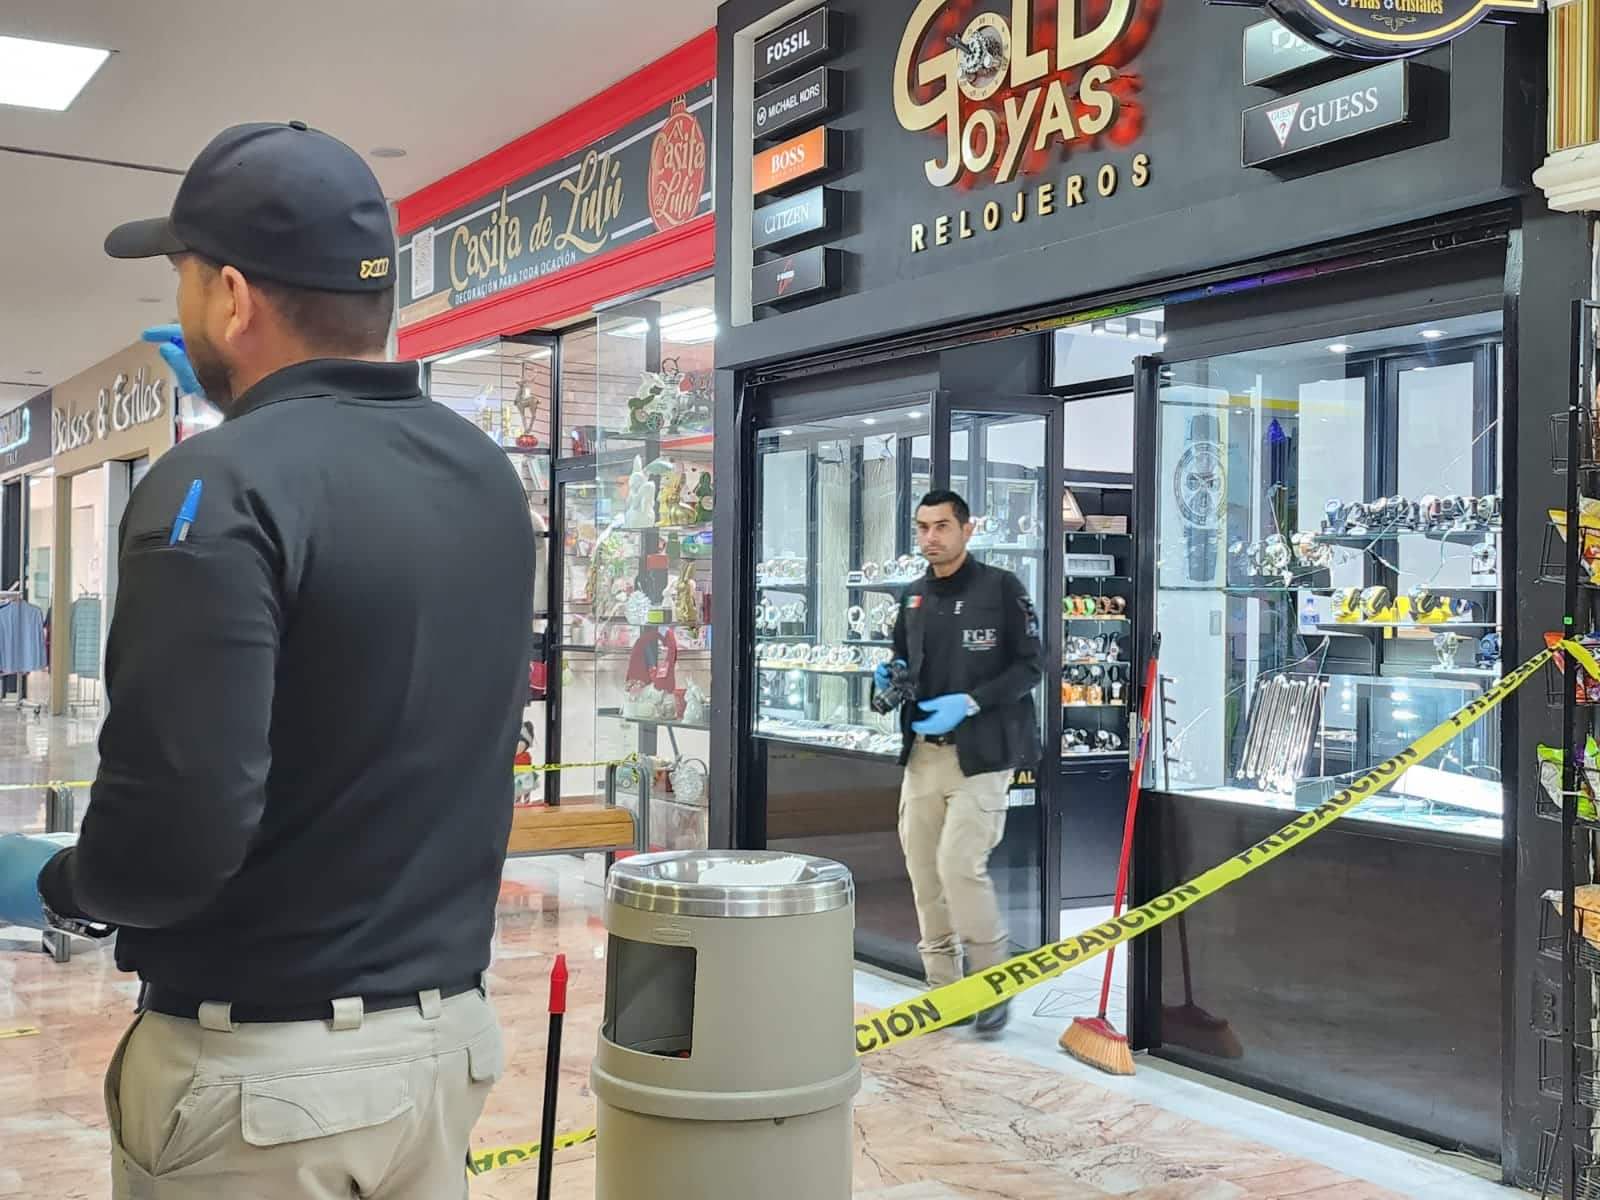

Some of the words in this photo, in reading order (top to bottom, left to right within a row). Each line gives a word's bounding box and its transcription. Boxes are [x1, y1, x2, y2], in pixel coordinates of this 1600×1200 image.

[767, 29, 810, 65] FOSSIL
[893, 0, 1134, 131] GOLD
[768, 95, 799, 118] MICHAEL
[800, 83, 820, 103] KORS
[1299, 87, 1379, 132] GUESS
[651, 121, 705, 177] Casita
[925, 64, 1117, 188] JOYAS
[771, 144, 805, 174] BOSS
[450, 184, 522, 291] Casita
[529, 195, 553, 252] de
[554, 150, 624, 253] Lulú
[764, 203, 809, 235] CITIZEN
[911, 153, 1150, 253] RELOJEROS
[500, 273, 517, 290] PARA
[519, 264, 539, 281] TODA
[113, 368, 162, 431] Estilos
